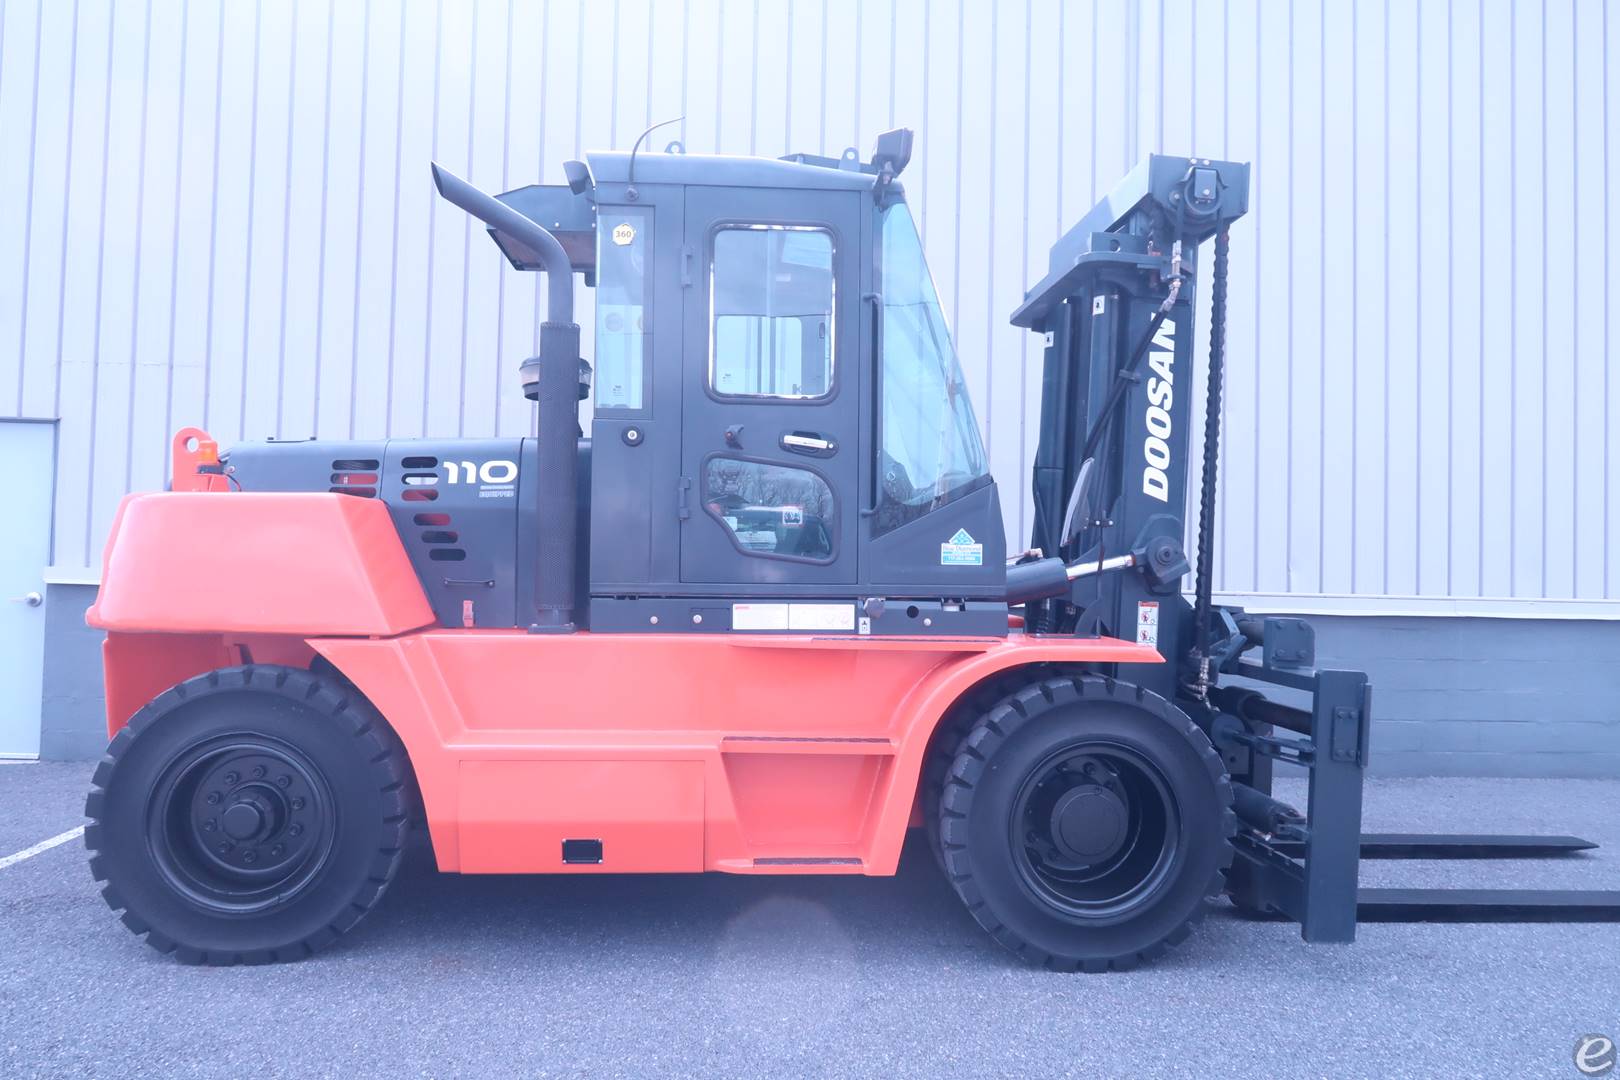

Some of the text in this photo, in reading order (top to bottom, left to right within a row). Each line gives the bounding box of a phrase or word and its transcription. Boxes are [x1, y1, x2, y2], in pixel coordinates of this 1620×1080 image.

[615, 230, 631, 238] 360
[1143, 312, 1176, 502] DOOSAN
[443, 460, 518, 484] 110
